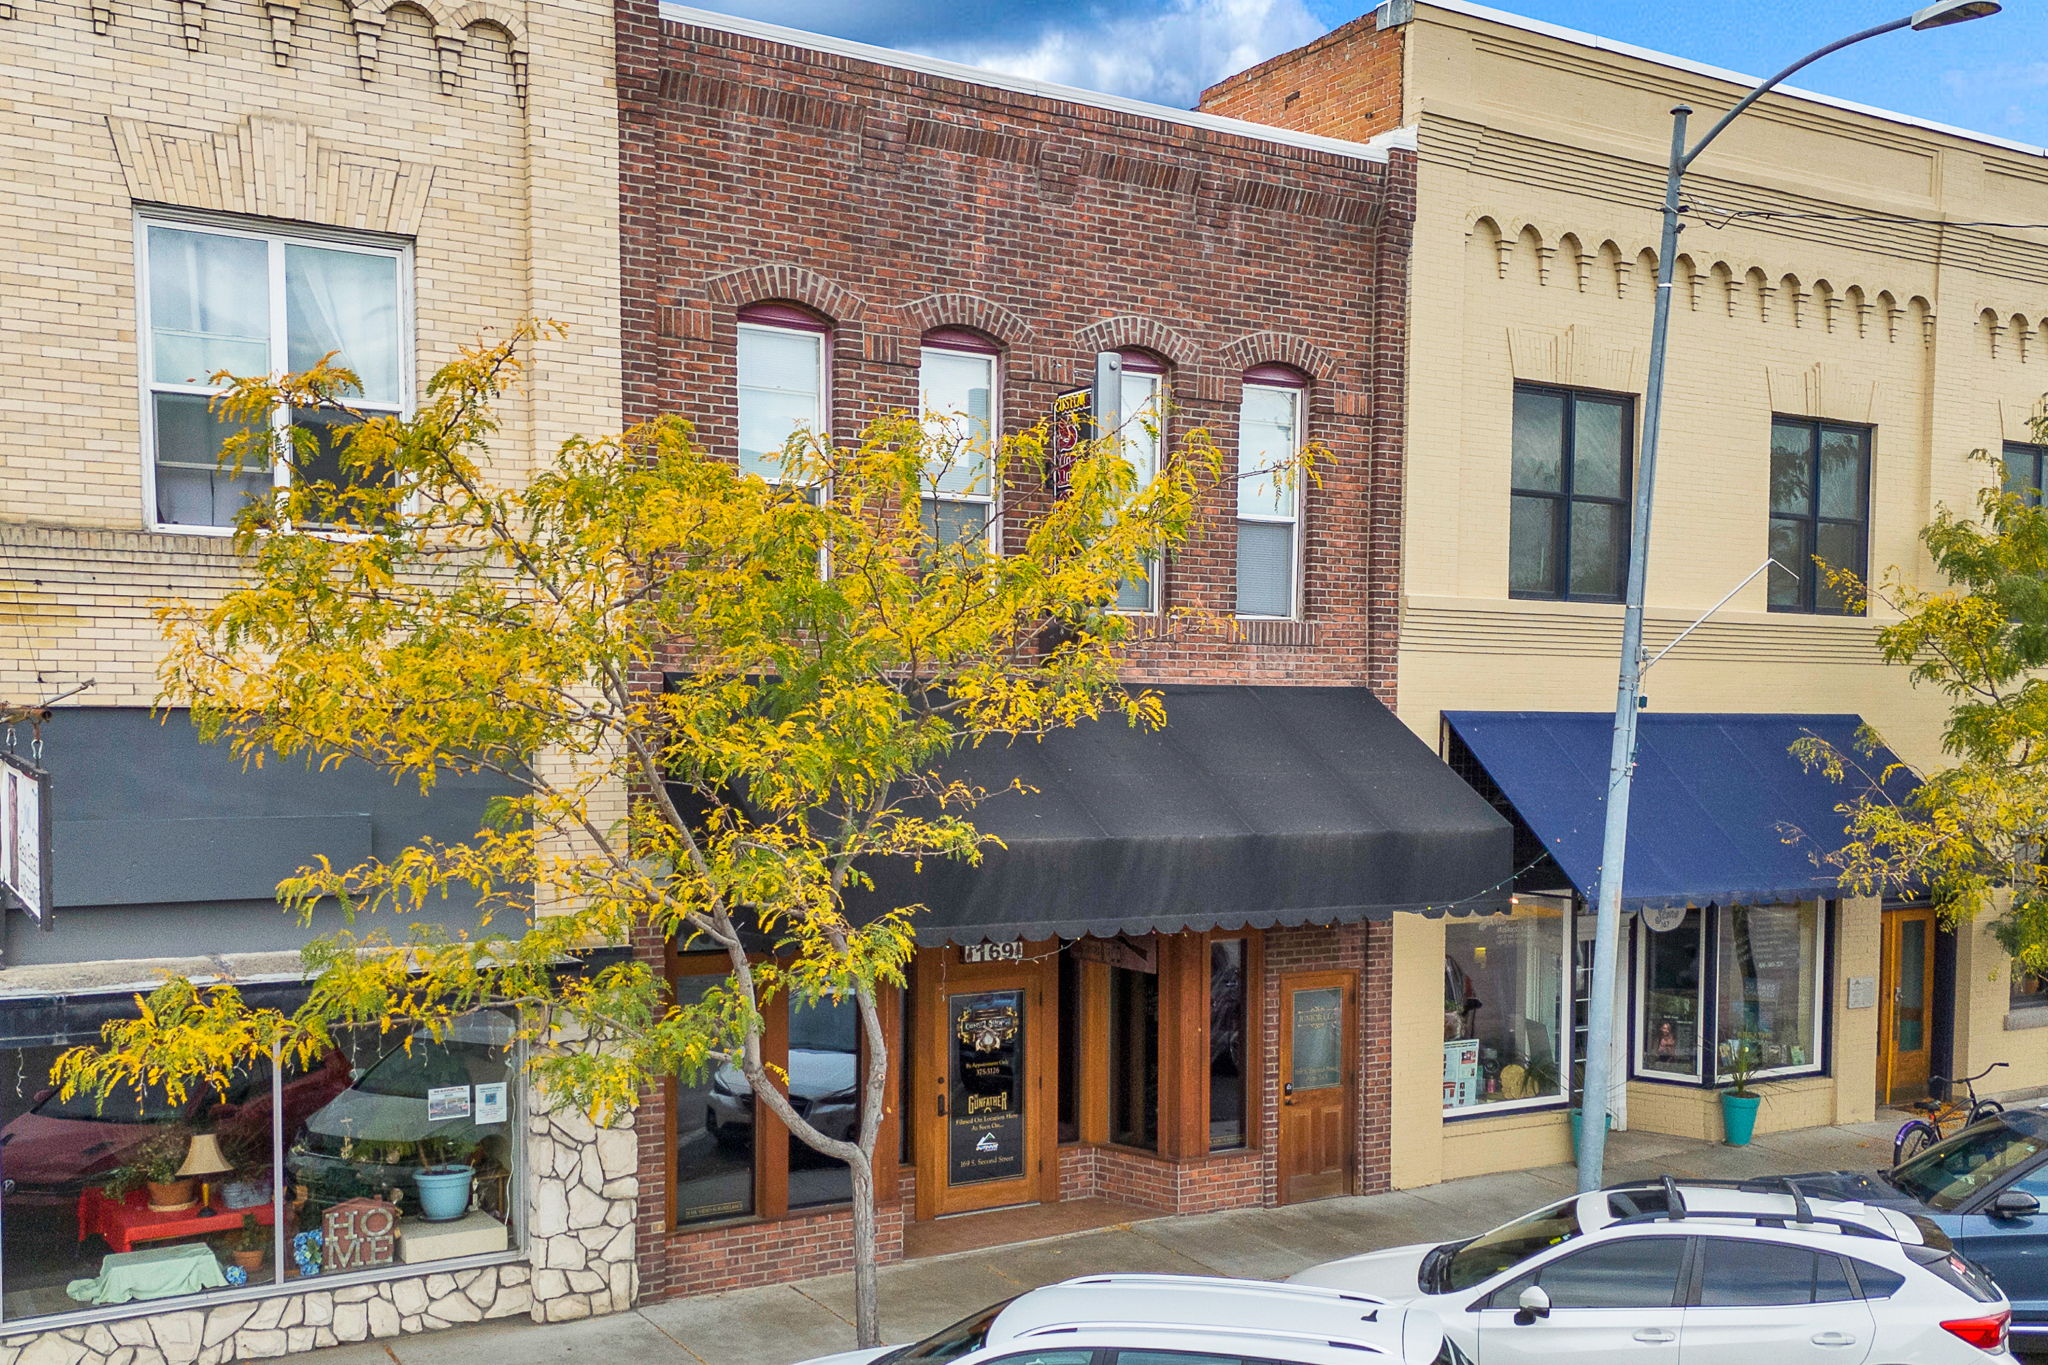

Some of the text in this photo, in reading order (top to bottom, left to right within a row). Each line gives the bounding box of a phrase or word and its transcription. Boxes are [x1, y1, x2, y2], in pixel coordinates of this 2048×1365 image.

[974, 943, 1014, 960] 169
[968, 1092, 1007, 1114] GUNFATHER
[325, 1208, 394, 1240] HO
[324, 1235, 394, 1269] ME
